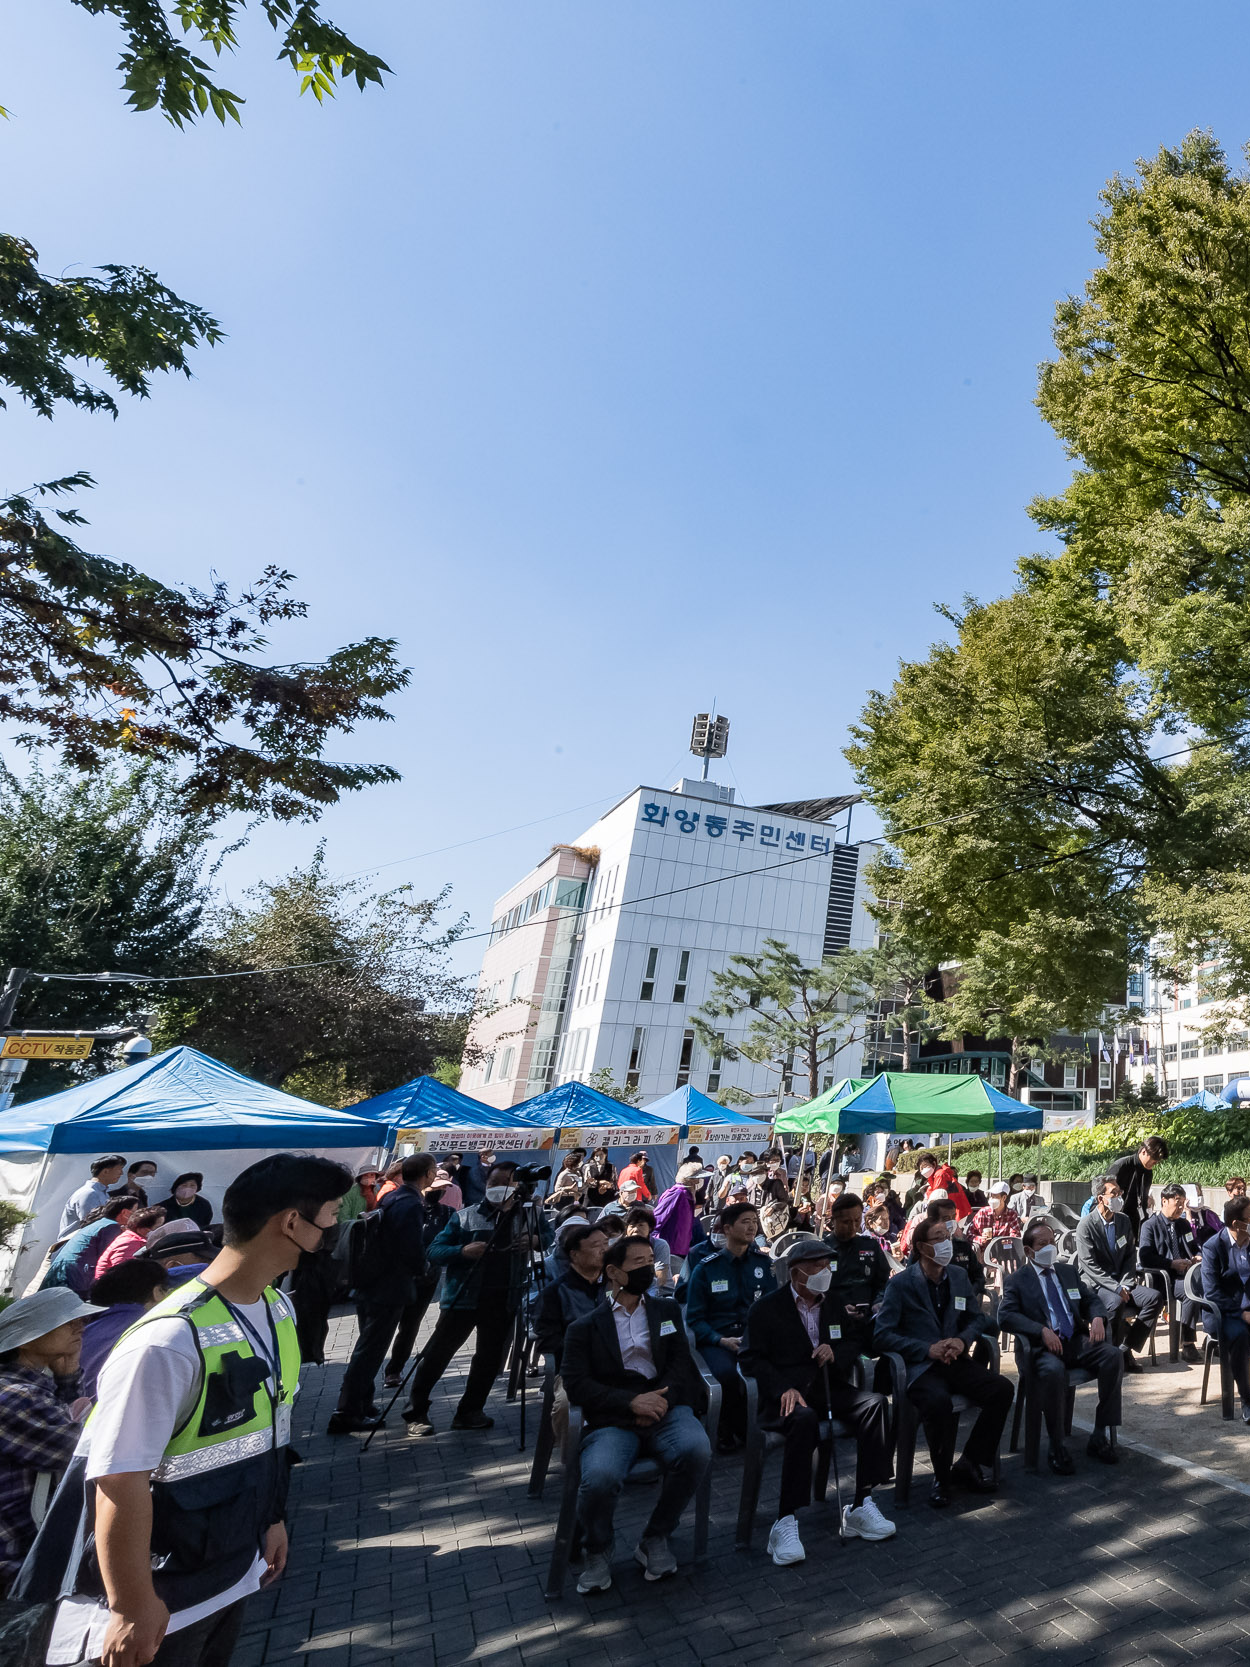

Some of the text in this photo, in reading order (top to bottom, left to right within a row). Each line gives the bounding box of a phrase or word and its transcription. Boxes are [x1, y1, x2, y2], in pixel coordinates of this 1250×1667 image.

[641, 802, 830, 857] 화양동주민센터
[8, 1042, 87, 1055] CCTV 작동중
[602, 1135, 651, 1146] 캘리그라피
[709, 1133, 730, 1142] 찾아가는
[731, 1133, 752, 1141] 마음건강
[428, 1139, 524, 1151] 광진푸드뱅크마켓센터
